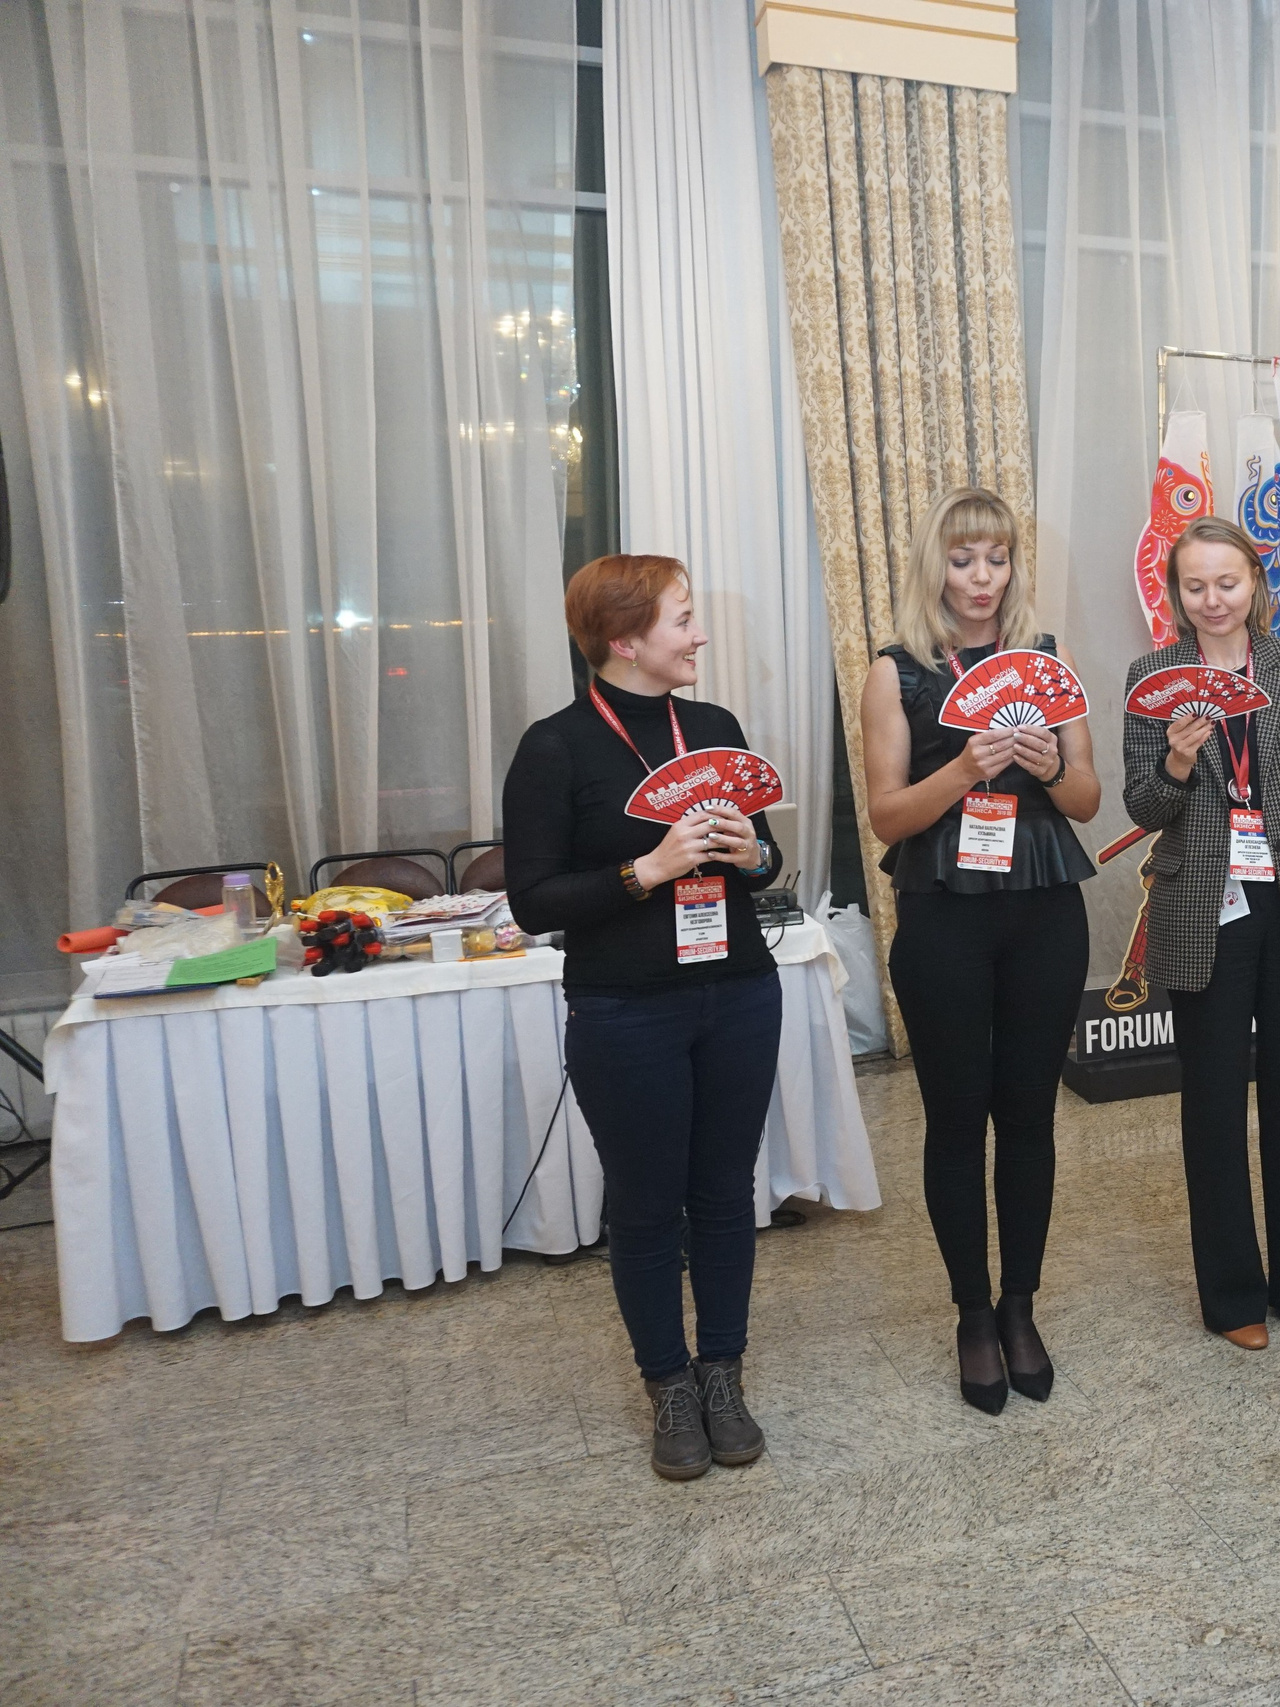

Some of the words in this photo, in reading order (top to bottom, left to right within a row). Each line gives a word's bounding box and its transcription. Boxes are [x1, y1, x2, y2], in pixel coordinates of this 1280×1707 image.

[989, 665, 1015, 684] ФОРУМ
[959, 672, 1019, 711] БЕЗОПАСНОСТЬ
[964, 694, 999, 718] БИЗНЕСА
[684, 763, 714, 781] ФОРУМ
[649, 769, 717, 803] БЕЗОПАСНОСТЬ
[653, 790, 693, 811] БИЗНЕСА
